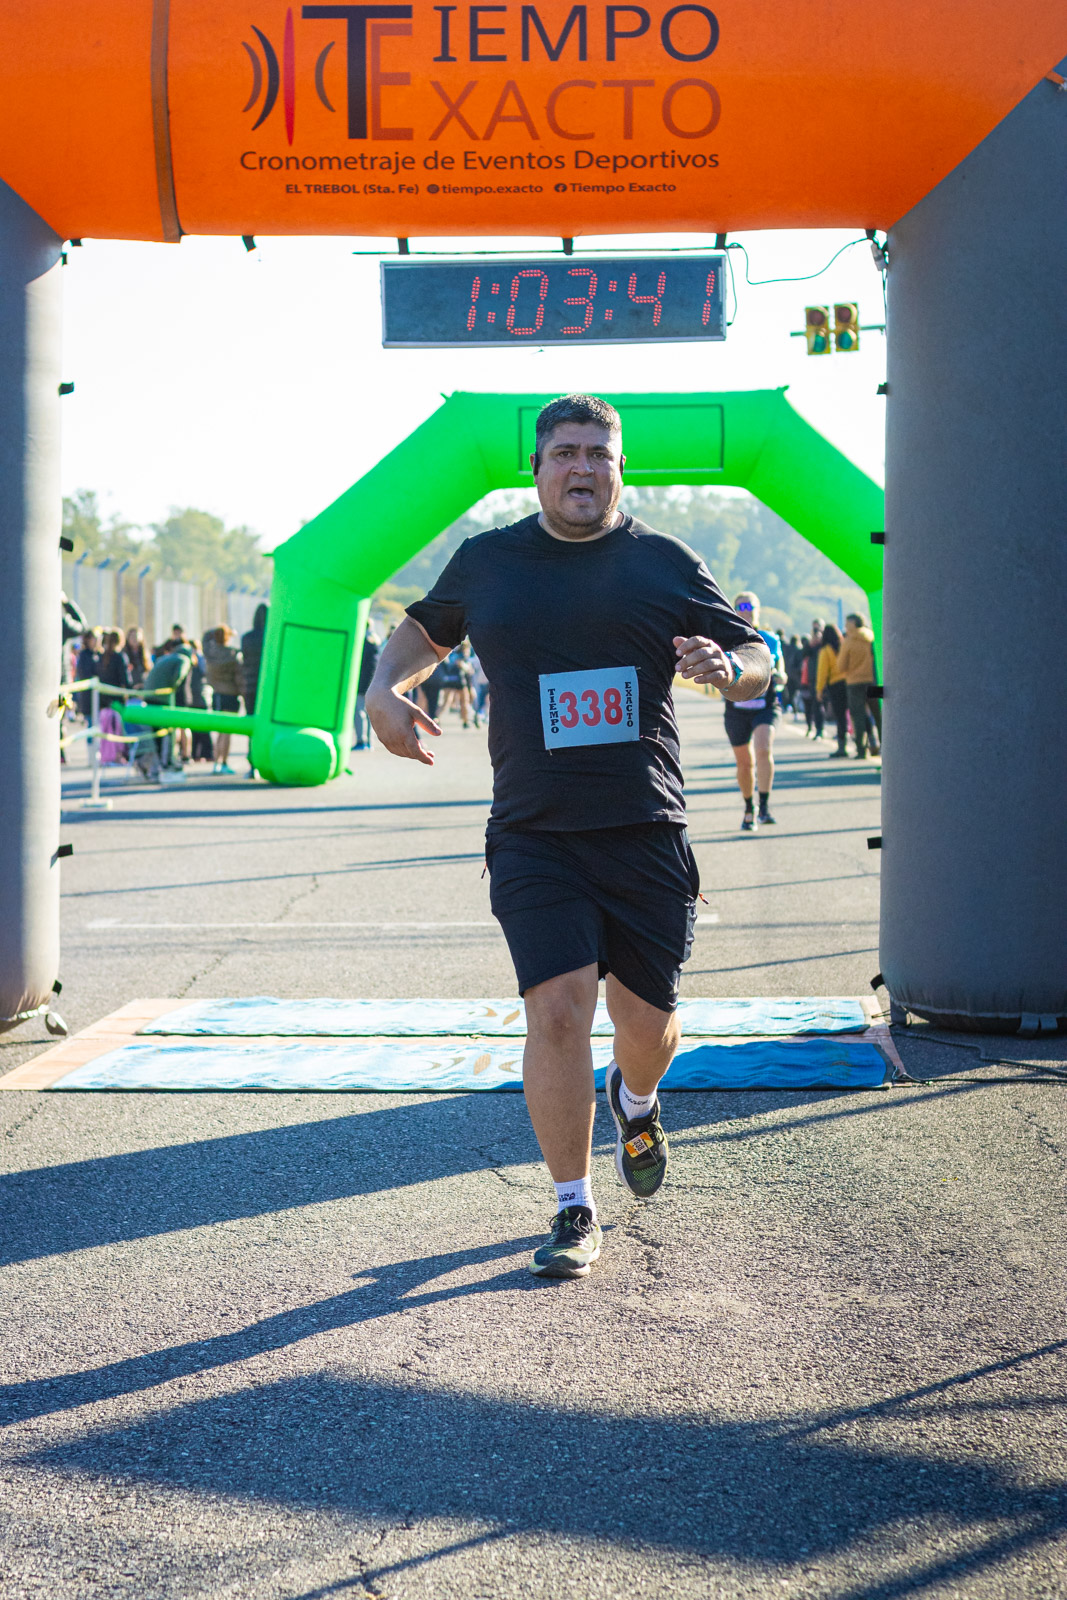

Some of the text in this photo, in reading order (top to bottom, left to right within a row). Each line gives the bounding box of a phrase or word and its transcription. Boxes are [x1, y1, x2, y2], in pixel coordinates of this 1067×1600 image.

[239, 150, 720, 175] Cronometraje de Eventos Deportivos
[285, 184, 419, 195] EL TREBOL (Sta. Fe)
[441, 183, 544, 195] tiempo.exacto
[569, 182, 677, 194] Tiempo Exacto
[466, 268, 716, 336] 1:03:41
[547, 688, 560, 734] TIEMPO
[558, 687, 624, 729] 338
[624, 681, 634, 728] EXACTO
